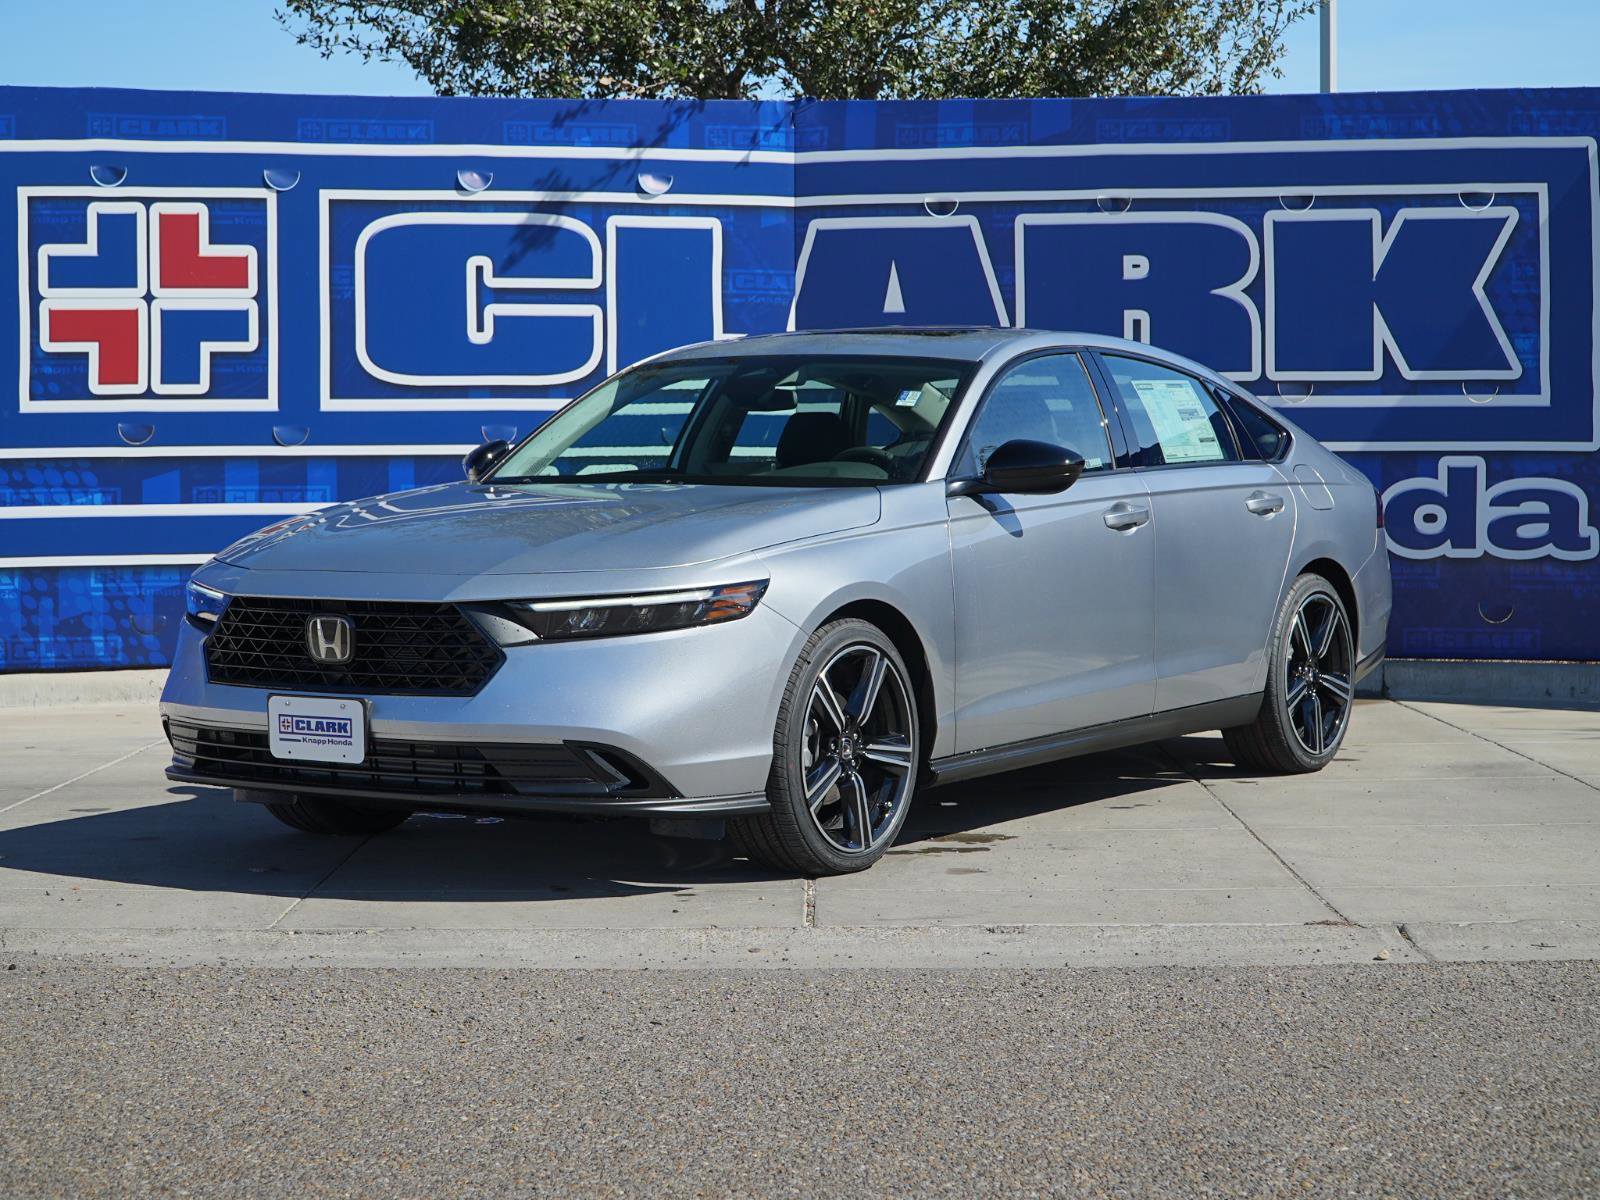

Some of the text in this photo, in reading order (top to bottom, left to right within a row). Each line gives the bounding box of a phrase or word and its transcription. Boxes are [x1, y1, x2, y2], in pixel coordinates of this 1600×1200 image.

[354, 205, 1523, 387] CLARK
[294, 719, 349, 734] CLARK
[302, 736, 353, 747] Knapp Honda
